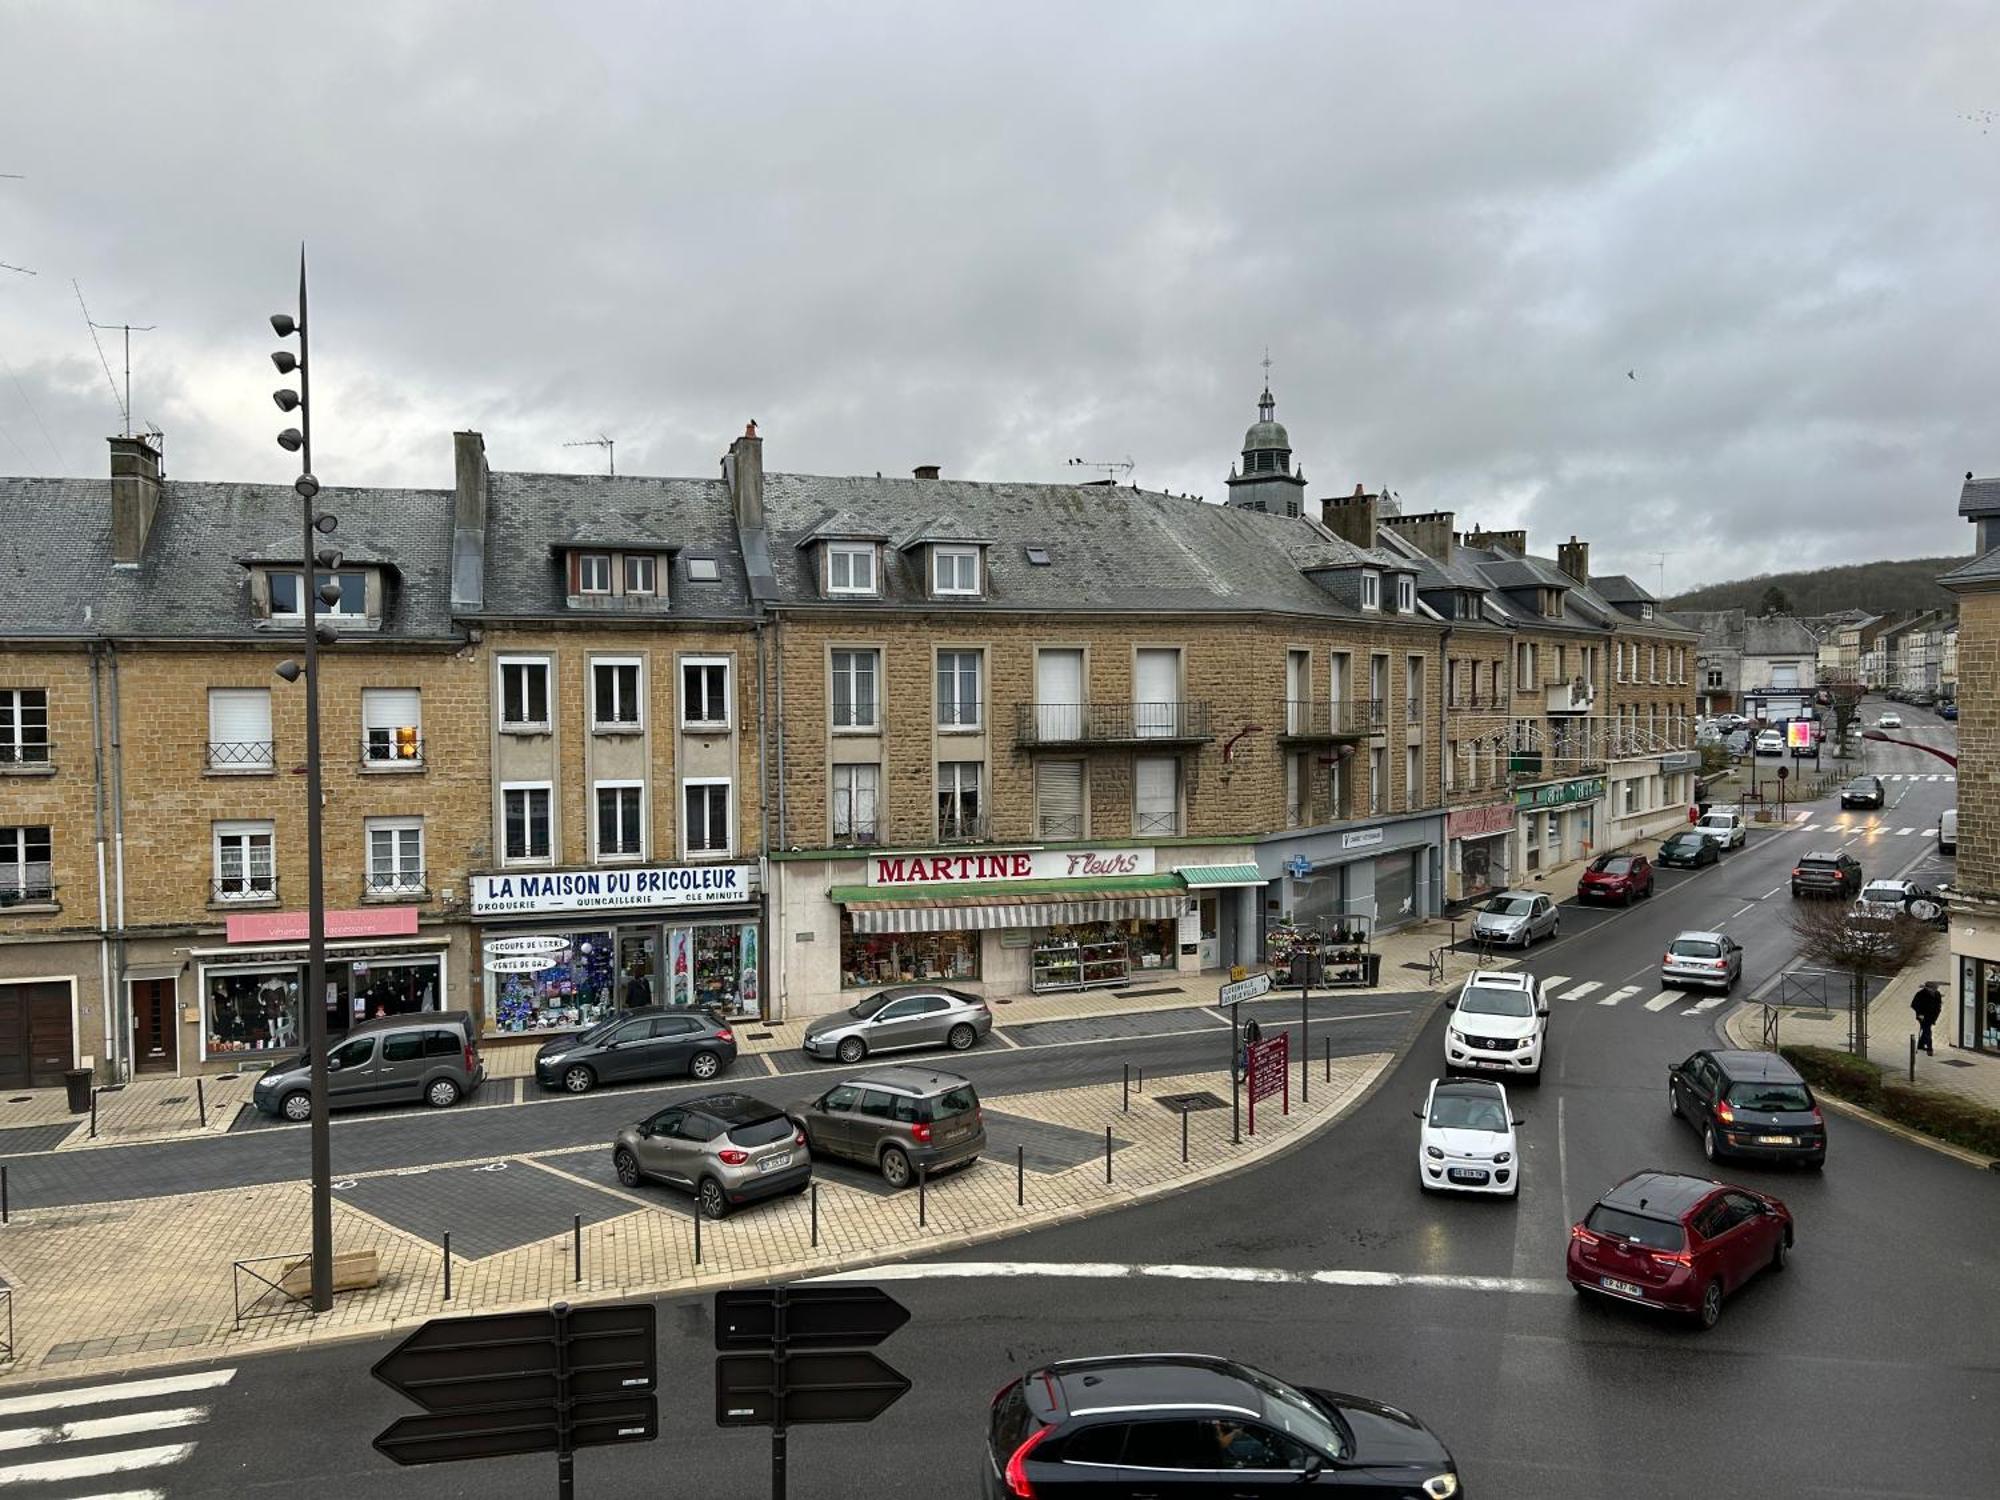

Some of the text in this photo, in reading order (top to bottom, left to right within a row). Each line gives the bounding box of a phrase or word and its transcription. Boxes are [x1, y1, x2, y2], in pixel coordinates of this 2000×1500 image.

[877, 853, 1139, 883] MARTINE Fleurs
[489, 868, 737, 899] LA MAISON DU BRICOLEUR
[478, 901, 536, 911] DROGUERIE
[576, 895, 652, 906] QUINCAILLERIE
[706, 891, 744, 900] MINUTE
[490, 942, 524, 951] DECOUPE
[526, 941, 536, 949] DE
[493, 961, 517, 969] VENTE
[519, 960, 529, 968] DE
